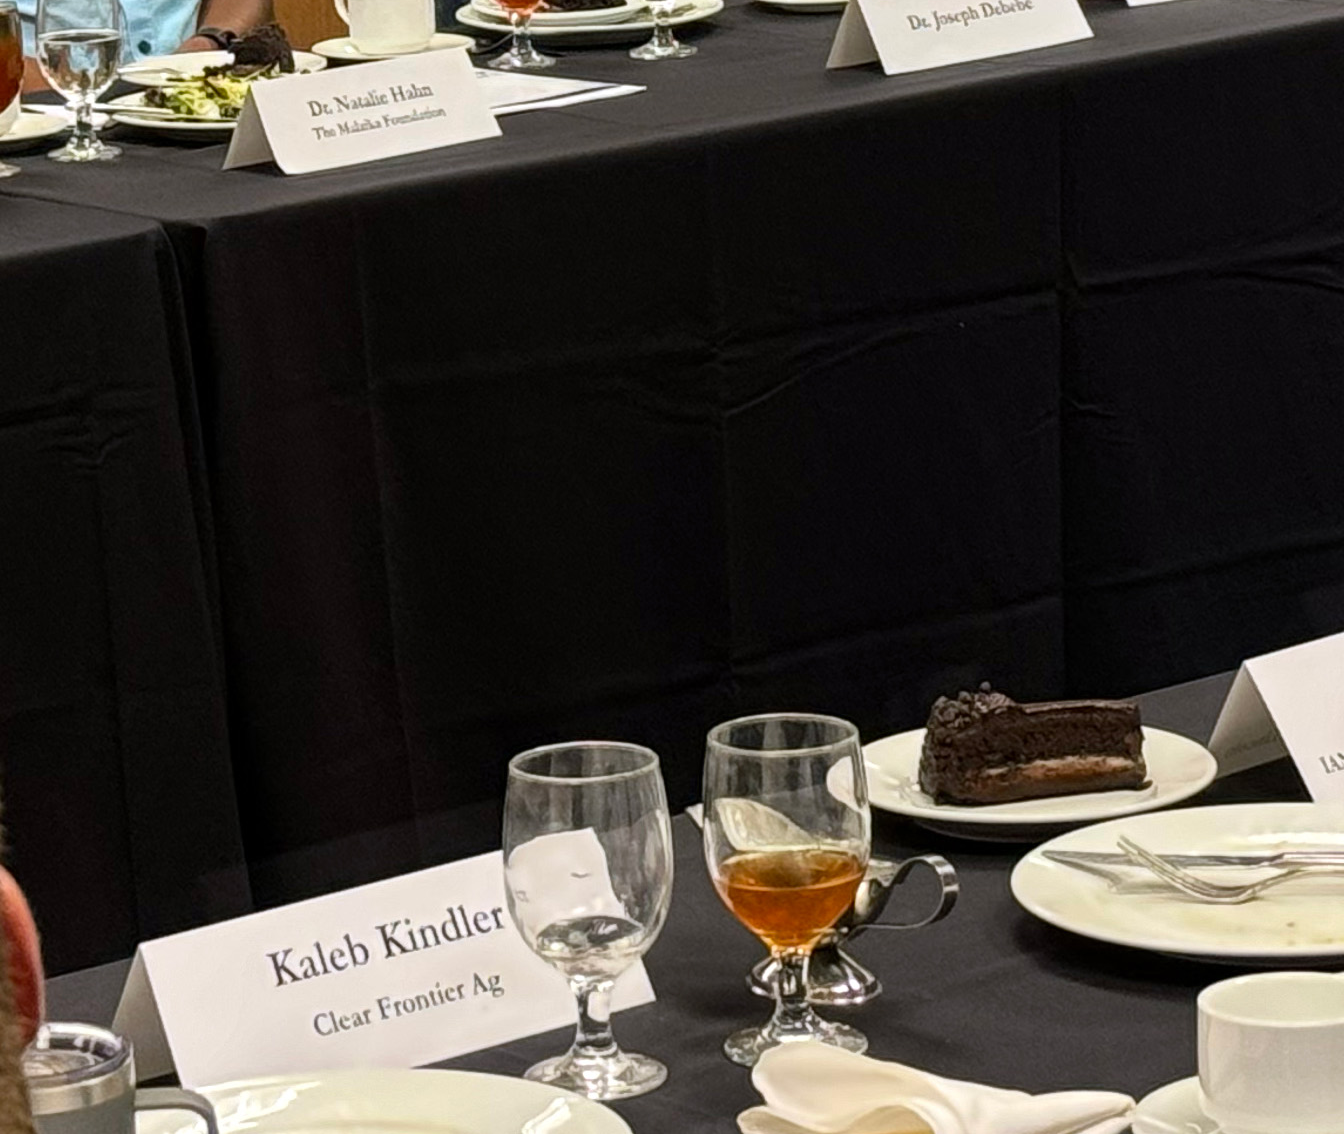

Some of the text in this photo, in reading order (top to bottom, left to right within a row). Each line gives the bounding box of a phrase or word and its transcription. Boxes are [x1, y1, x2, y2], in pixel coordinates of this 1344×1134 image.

[906, 14, 932, 31] Dr.
[931, 5, 980, 32] Joseph
[306, 83, 434, 117] Dr. Natalie Hahn
[312, 124, 336, 141] The
[383, 107, 447, 128] Foundation
[266, 903, 505, 988] Kaleb Kindler
[313, 971, 505, 1037] Clear Frontier Ag
